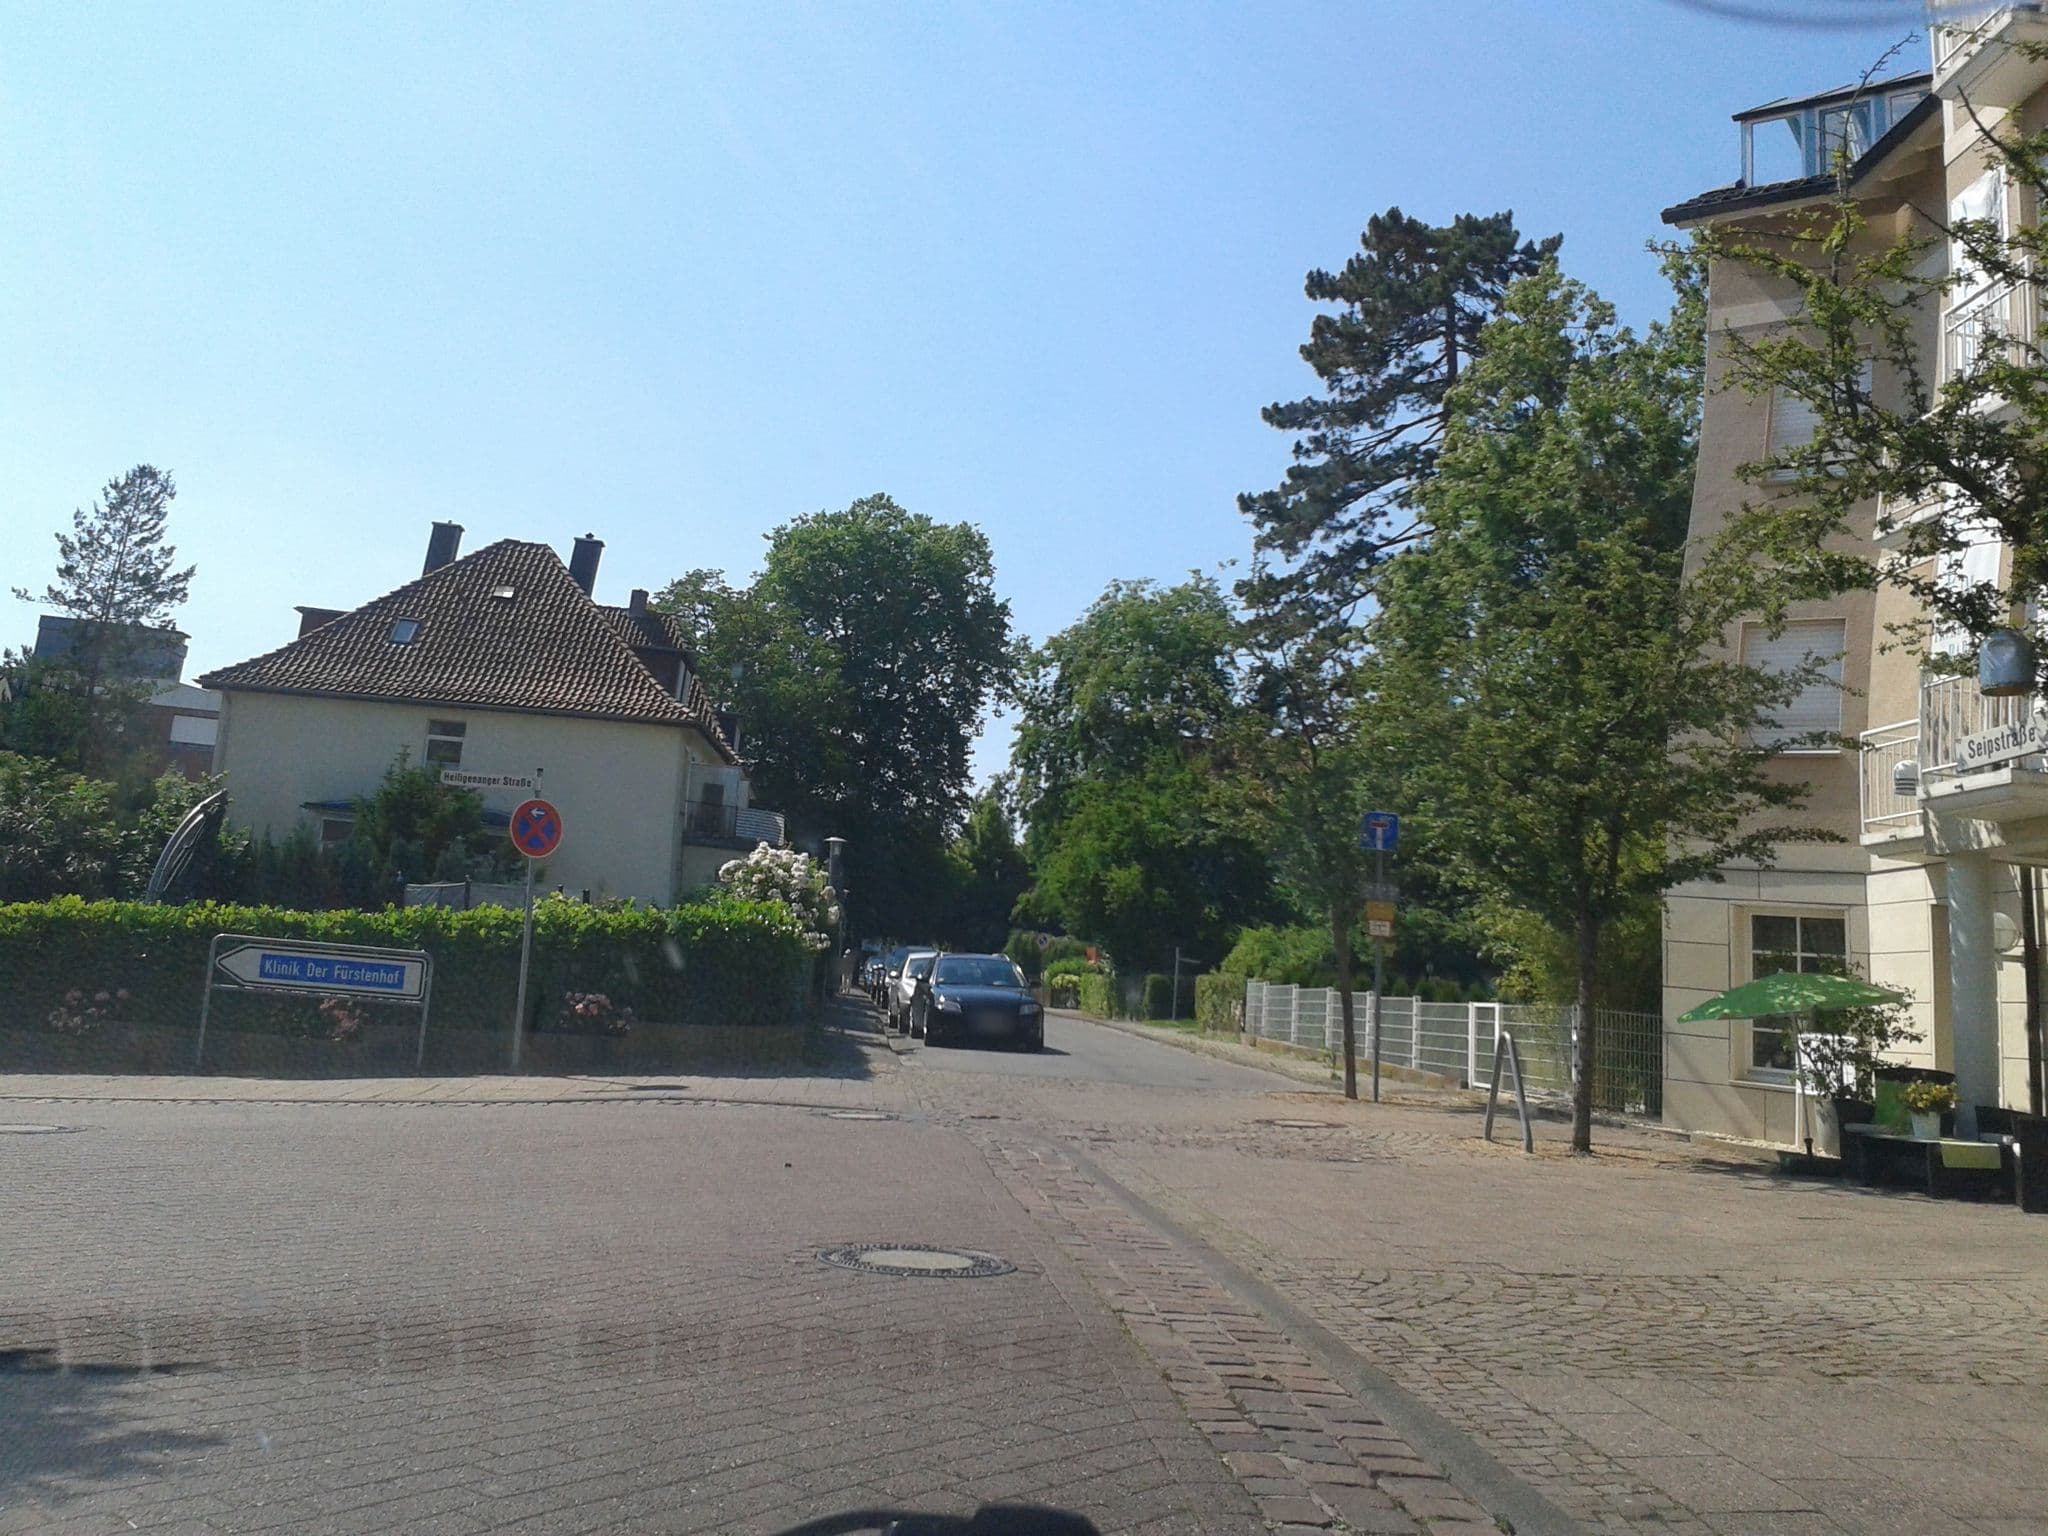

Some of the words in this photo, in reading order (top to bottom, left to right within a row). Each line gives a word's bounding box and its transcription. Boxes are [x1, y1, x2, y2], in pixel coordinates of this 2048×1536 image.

[1967, 724, 2036, 759] Seipstraße
[444, 772, 500, 786] Heiligenanger
[503, 776, 532, 788] Straße
[265, 959, 300, 977] Klinik
[306, 962, 328, 978] Der
[334, 965, 400, 985] Fürstenhof
